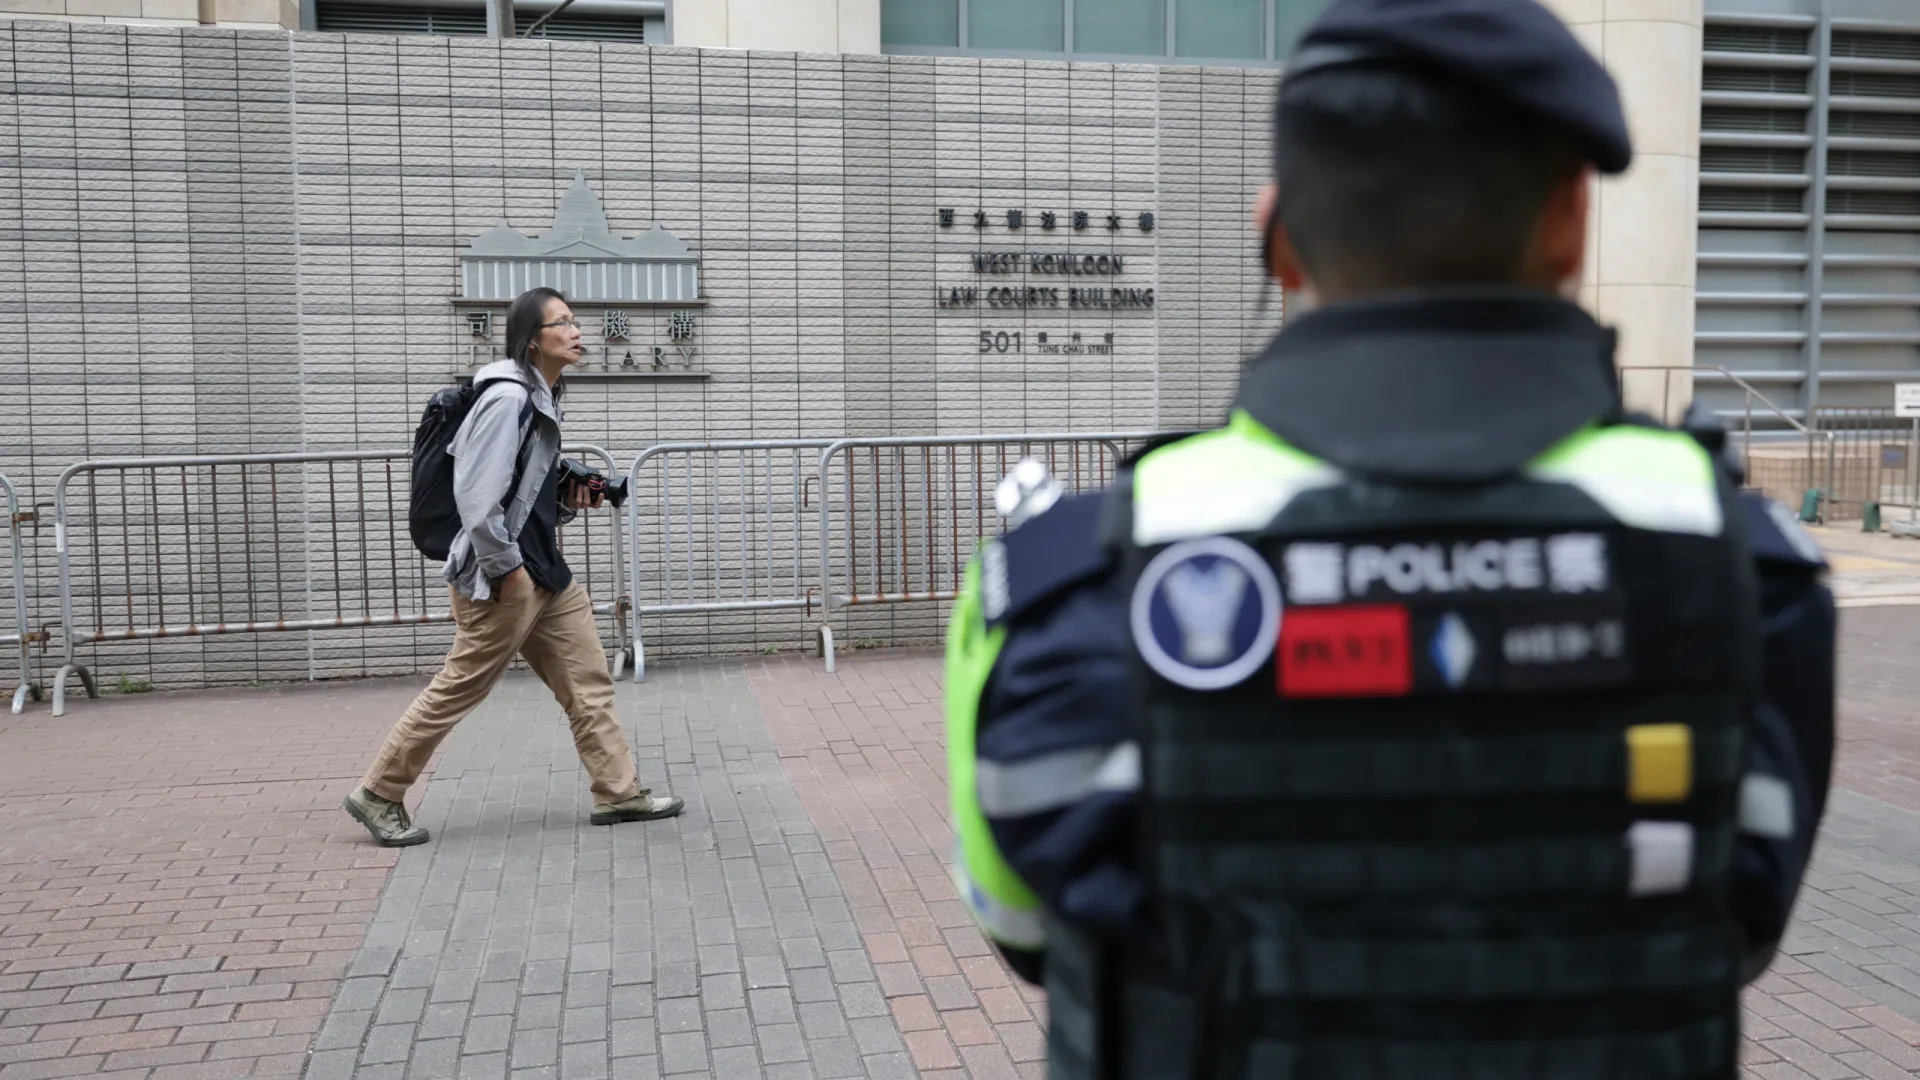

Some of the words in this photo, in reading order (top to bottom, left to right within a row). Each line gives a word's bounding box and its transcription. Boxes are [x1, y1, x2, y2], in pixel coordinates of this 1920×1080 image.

[972, 252, 1020, 275] WEST
[1029, 252, 1123, 275] KOWLOON
[938, 285, 979, 308] LAW
[986, 286, 1058, 308] COURTS
[1067, 287, 1155, 308] BUILDING
[466, 310, 696, 341] 司機構
[979, 330, 1021, 353] 501
[1038, 344, 1059, 354] TUNG
[1062, 344, 1084, 355] CHAU
[1087, 345, 1114, 355] STREET
[1347, 538, 1543, 595] POLICE
